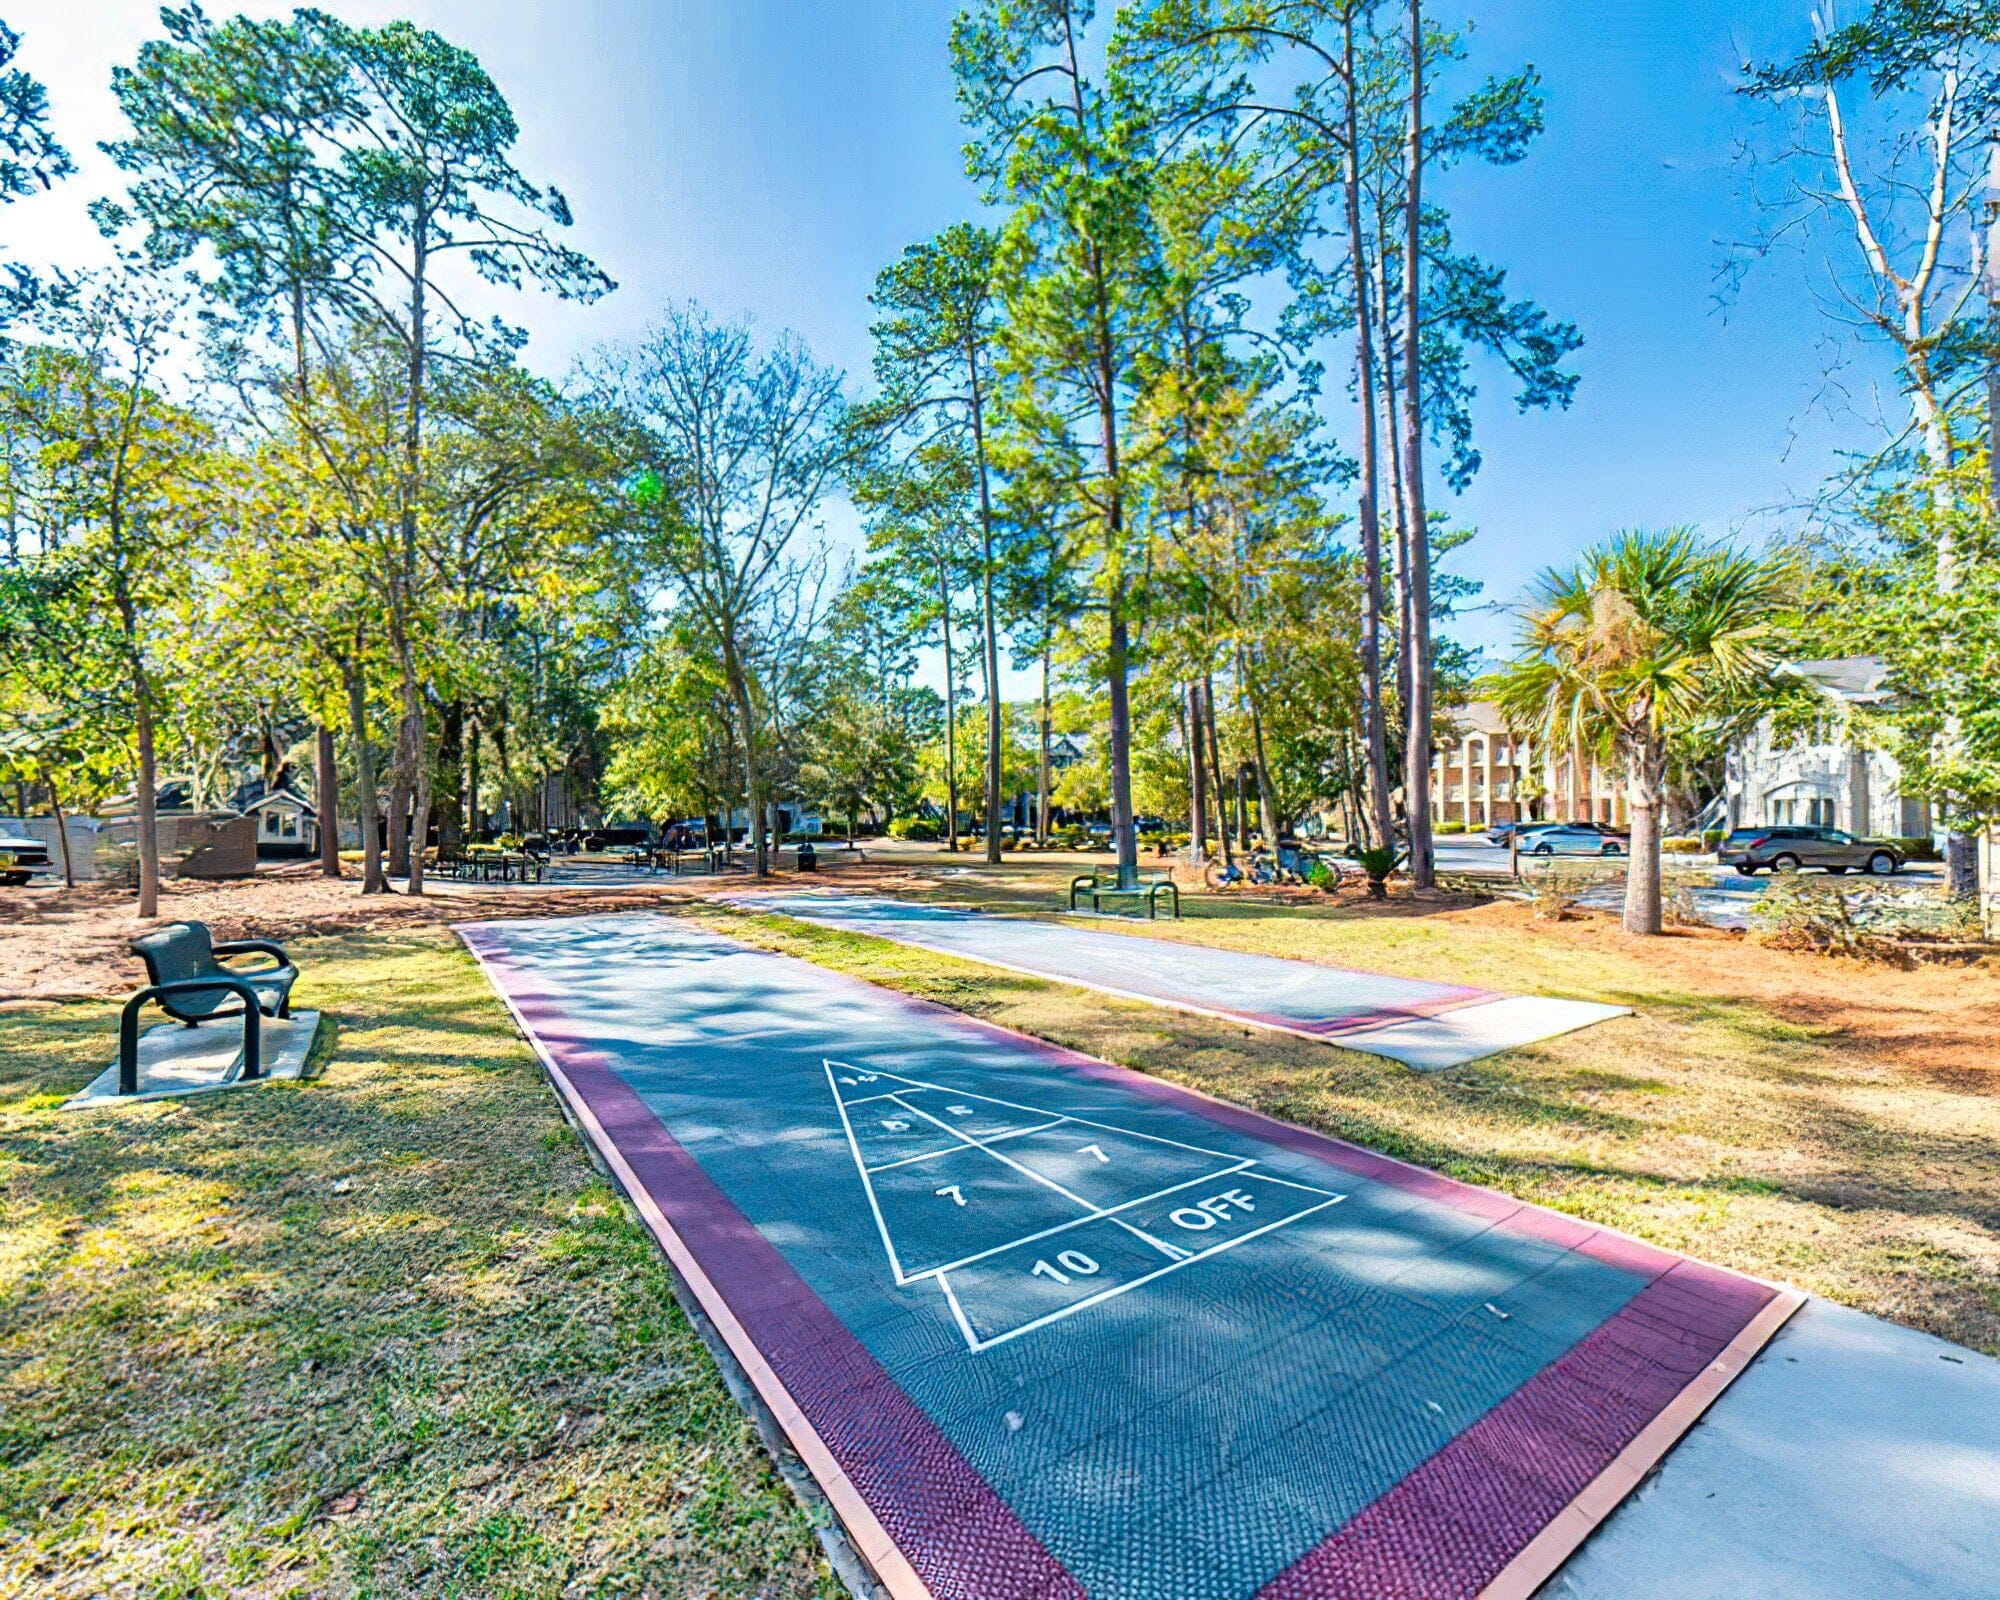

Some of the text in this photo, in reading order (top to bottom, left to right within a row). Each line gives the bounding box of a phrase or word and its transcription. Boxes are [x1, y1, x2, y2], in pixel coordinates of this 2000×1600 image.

[935, 1185, 967, 1207] 7
[1031, 1188, 1256, 1285] 10 OFF
